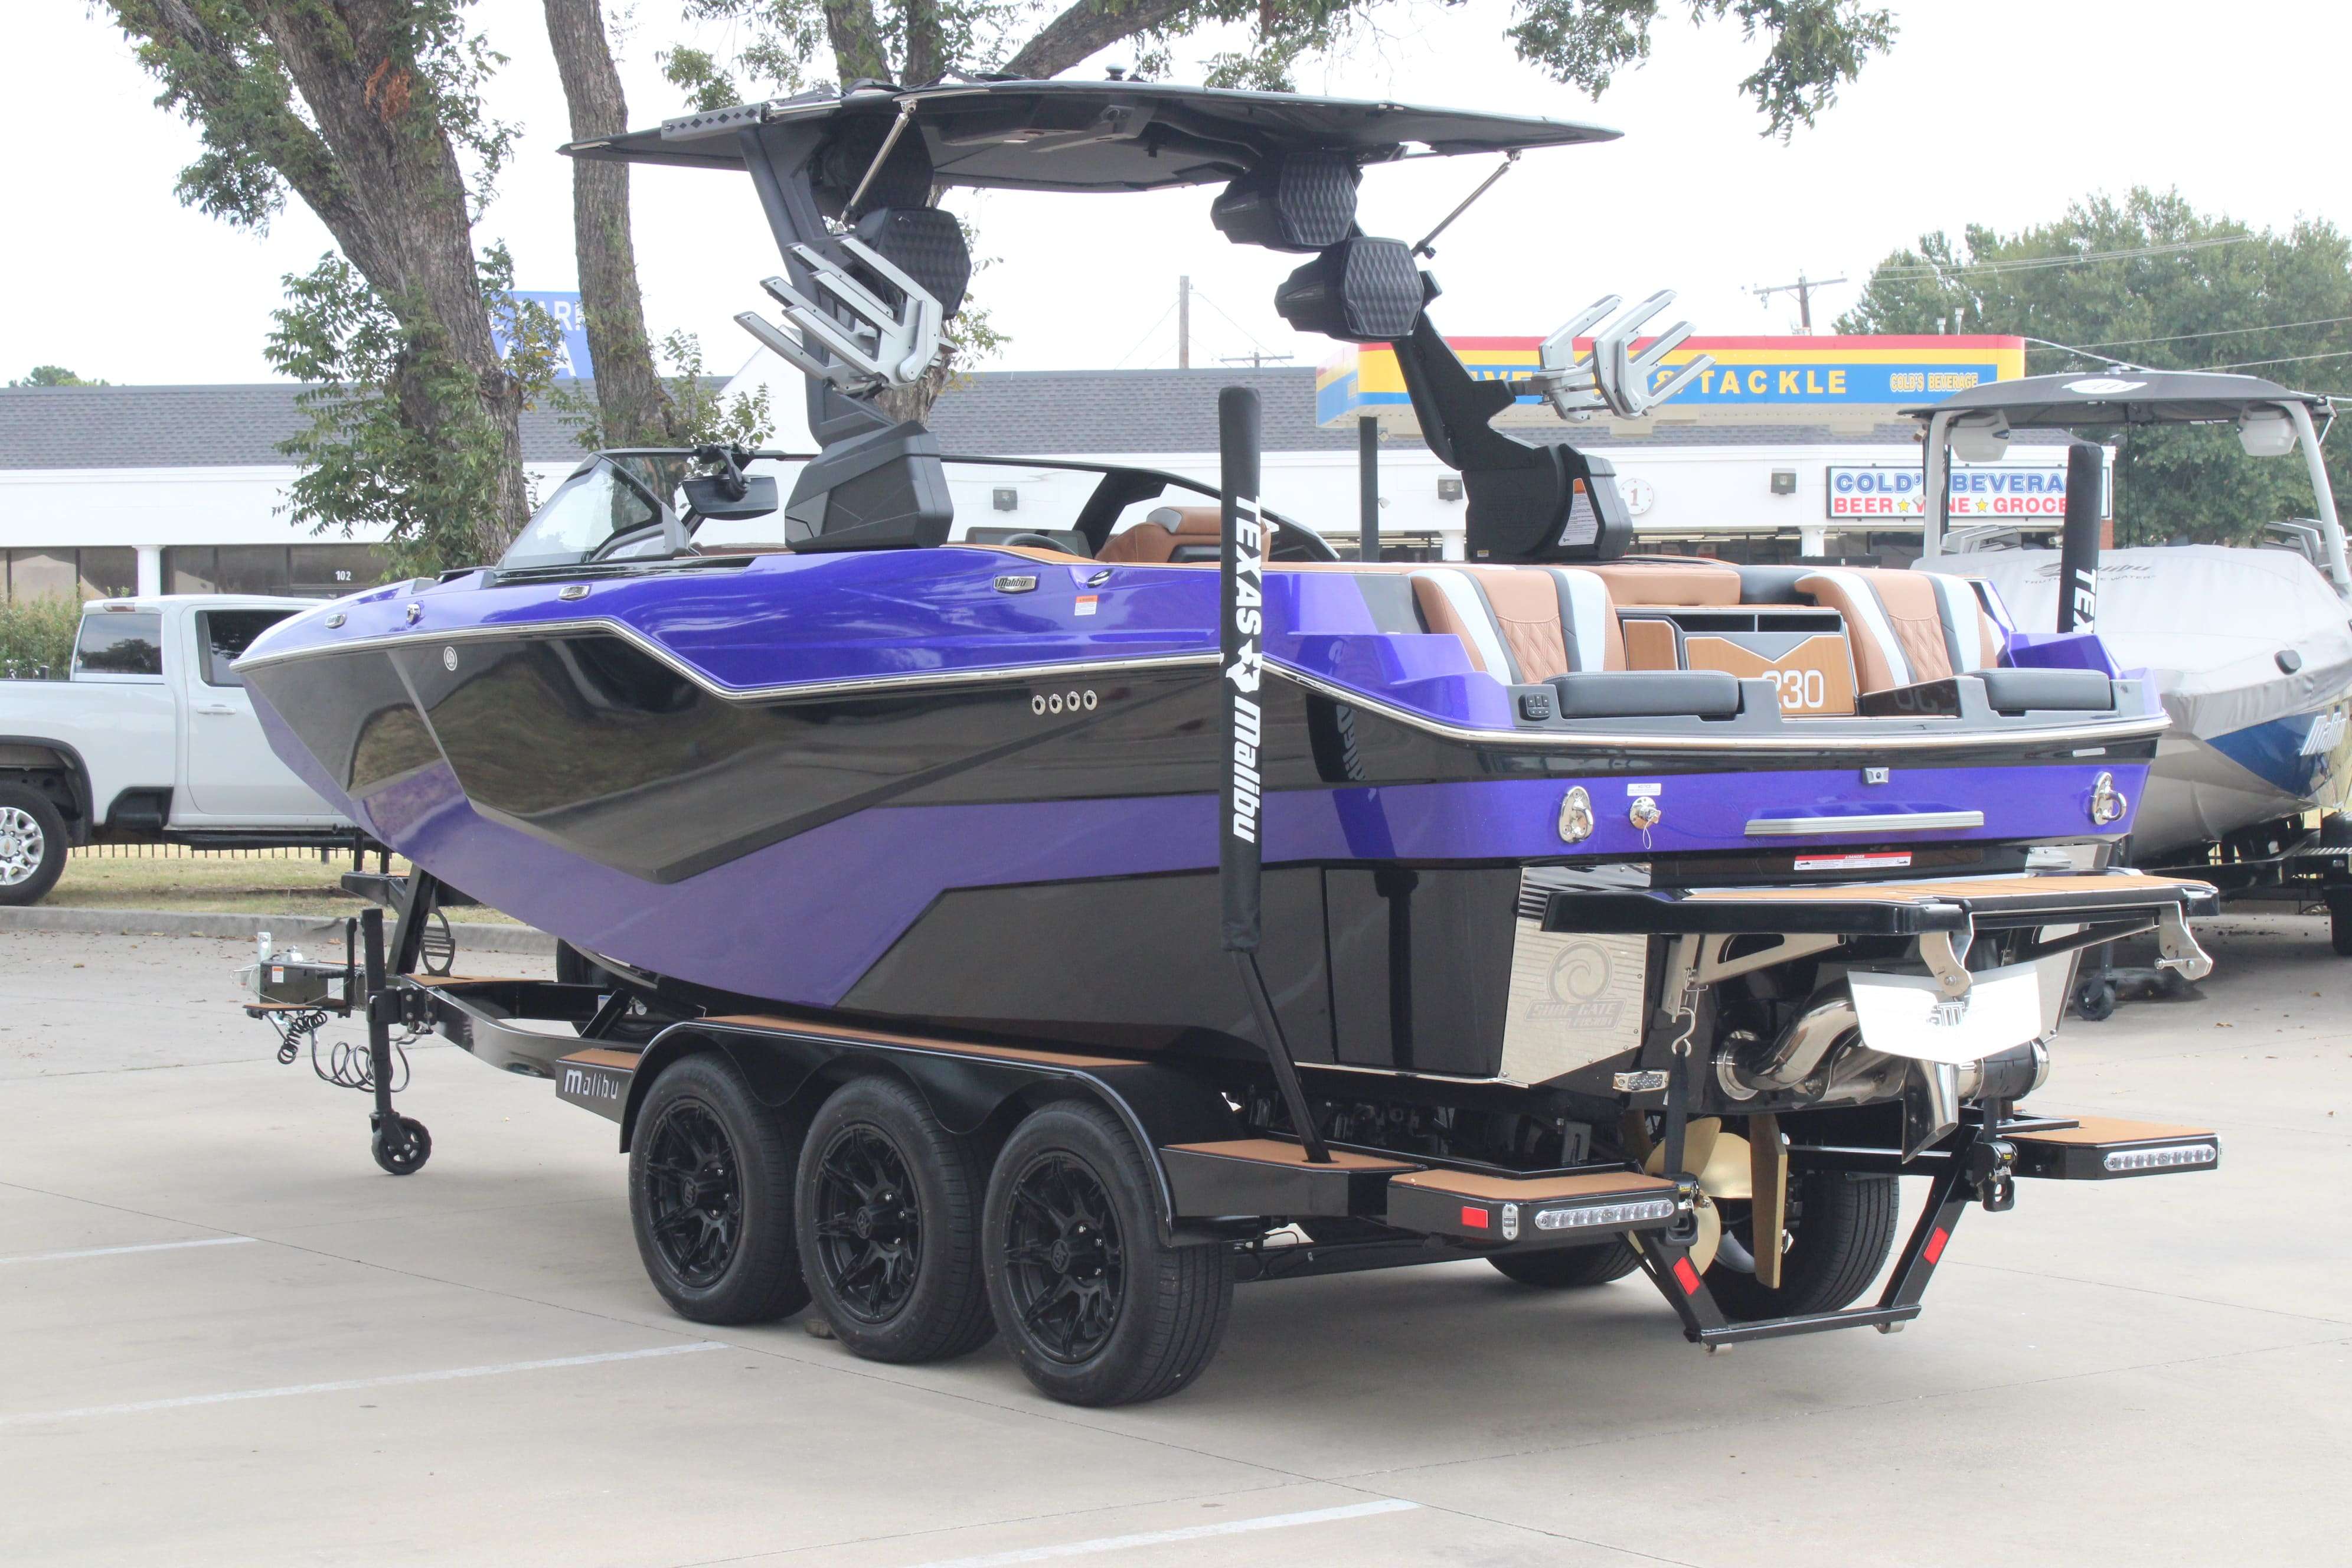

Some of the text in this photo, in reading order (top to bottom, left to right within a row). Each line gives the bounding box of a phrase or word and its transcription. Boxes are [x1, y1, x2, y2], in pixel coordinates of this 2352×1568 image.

[1699, 370, 1847, 394] TACKLE
[1890, 373, 1978, 392] COLD'S BEVERAGE
[1834, 473, 2067, 494] COLD' BEVERA
[1834, 497, 1893, 513] BEER
[1994, 497, 2068, 513] GROCE
[335, 570, 351, 581] 102
[1236, 495, 1262, 635] TEXAS
[2073, 569, 2097, 633] TEX
